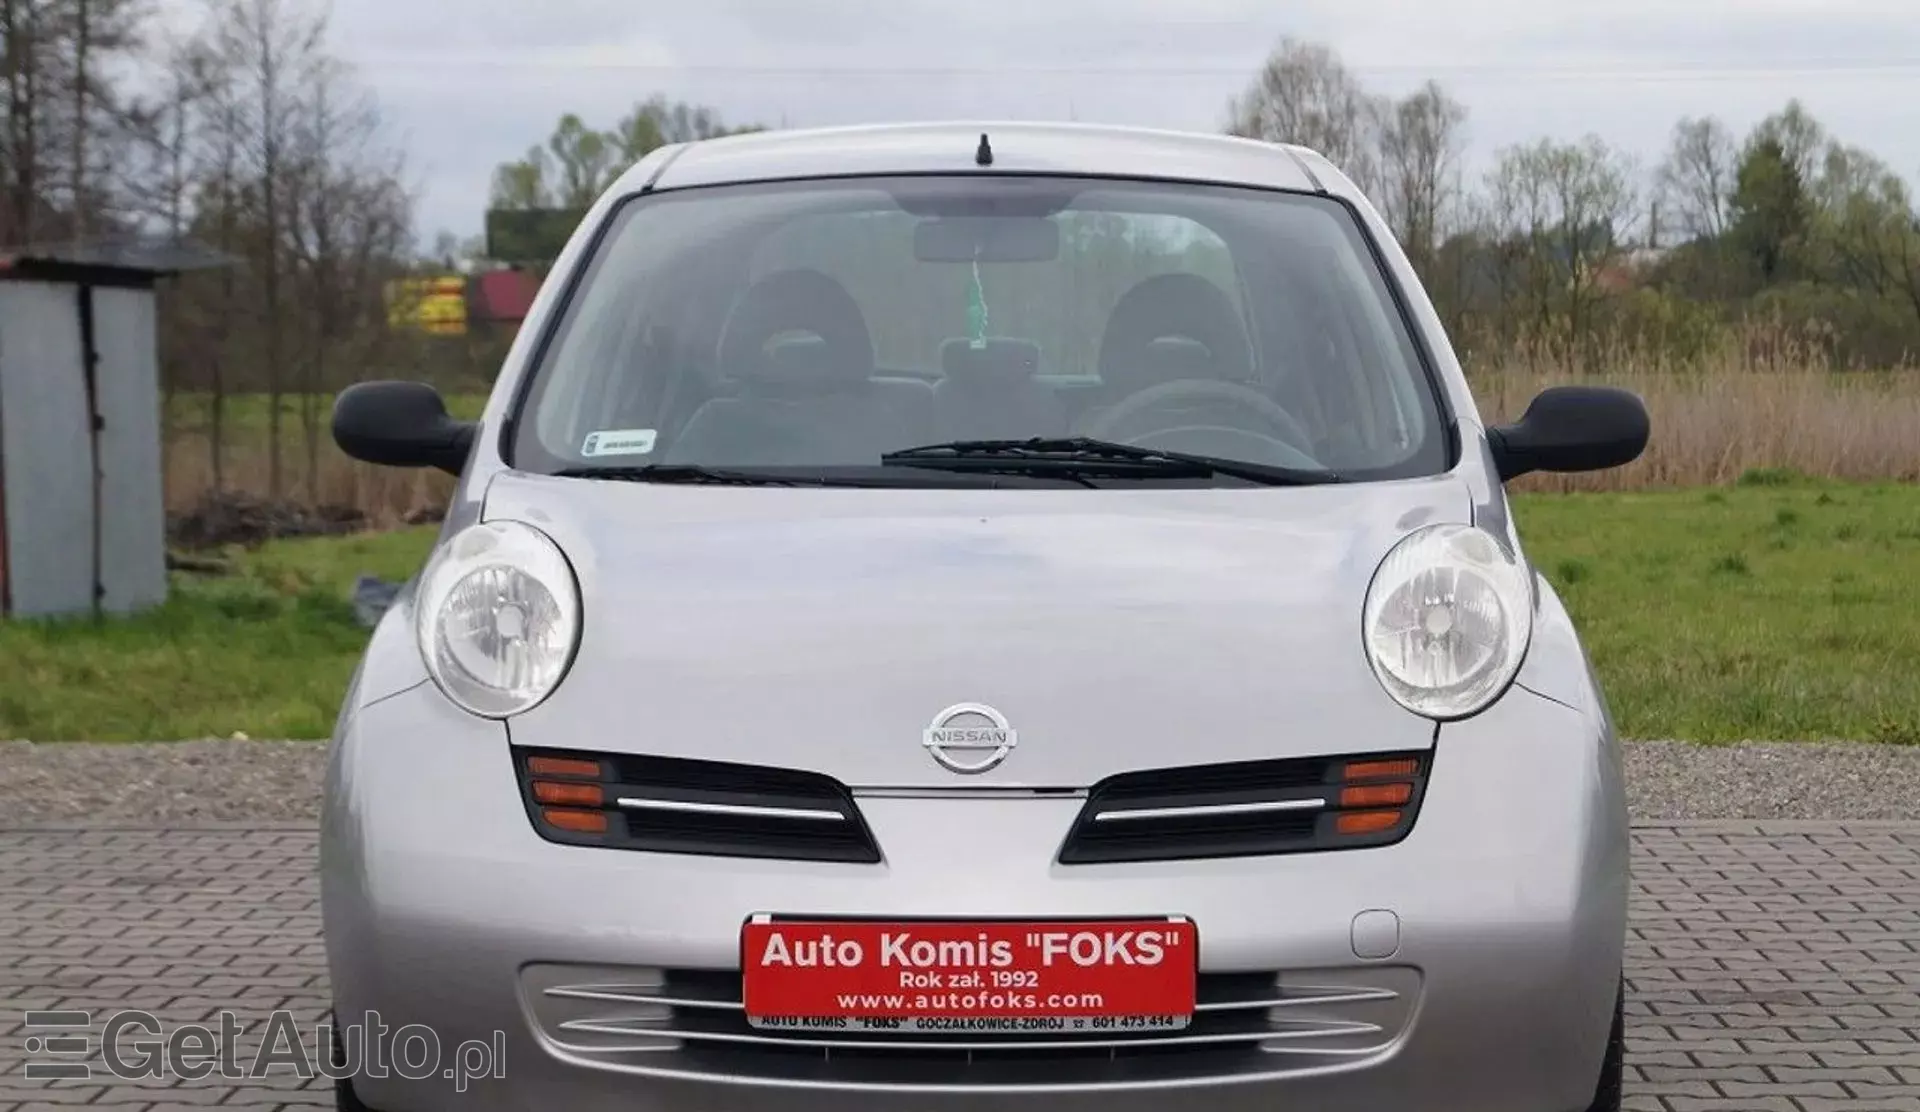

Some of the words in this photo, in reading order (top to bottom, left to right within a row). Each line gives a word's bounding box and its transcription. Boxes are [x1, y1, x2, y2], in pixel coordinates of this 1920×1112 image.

[931, 730, 1007, 743] NISSAN
[761, 932, 865, 967] Auto
[881, 931, 1014, 967] Komis
[1026, 931, 1180, 967] "FOKS"
[900, 971, 943, 988] Rok
[948, 969, 986, 988] zał.
[990, 970, 1039, 988] 1992
[837, 991, 1104, 1010] www.autofoks.com
[761, 1015, 798, 1026] AUTO
[802, 1015, 848, 1028] KOMIS
[855, 1016, 908, 1029] "FOKS"
[1092, 1016, 1116, 1028] 601
[1120, 1016, 1146, 1028] 473
[1149, 1015, 1174, 1027] 414
